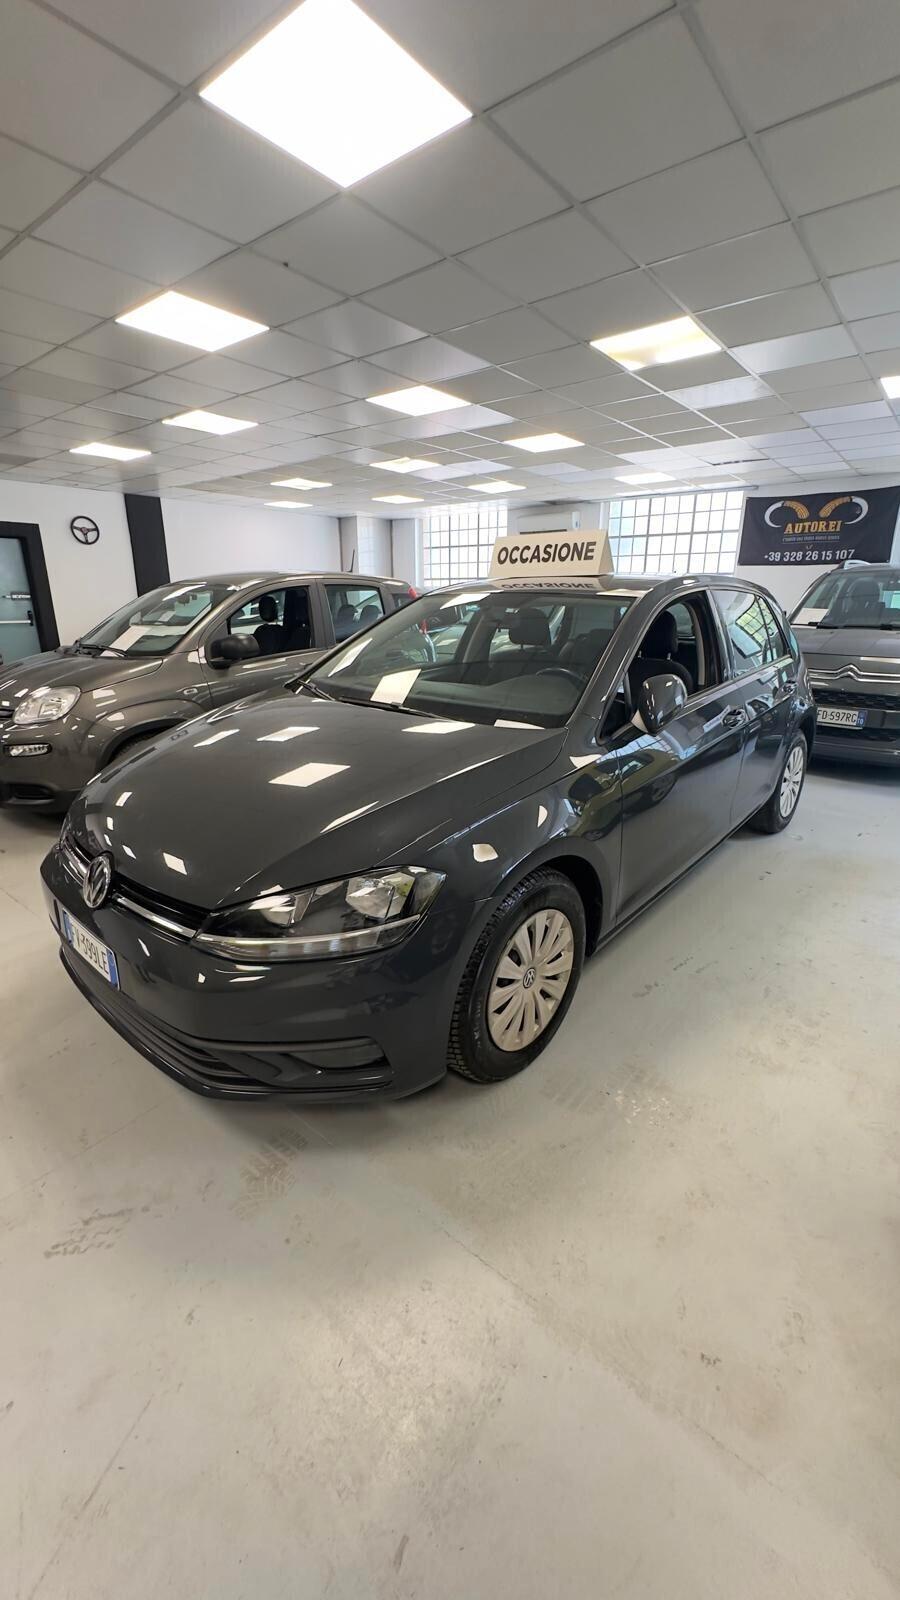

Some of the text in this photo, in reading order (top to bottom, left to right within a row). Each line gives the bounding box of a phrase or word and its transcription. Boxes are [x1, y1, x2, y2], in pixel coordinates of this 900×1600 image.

[784, 521, 842, 534] AUTOREI
[497, 541, 597, 565] OCCASIONE
[764, 549, 855, 562] +39 328 26 15 107
